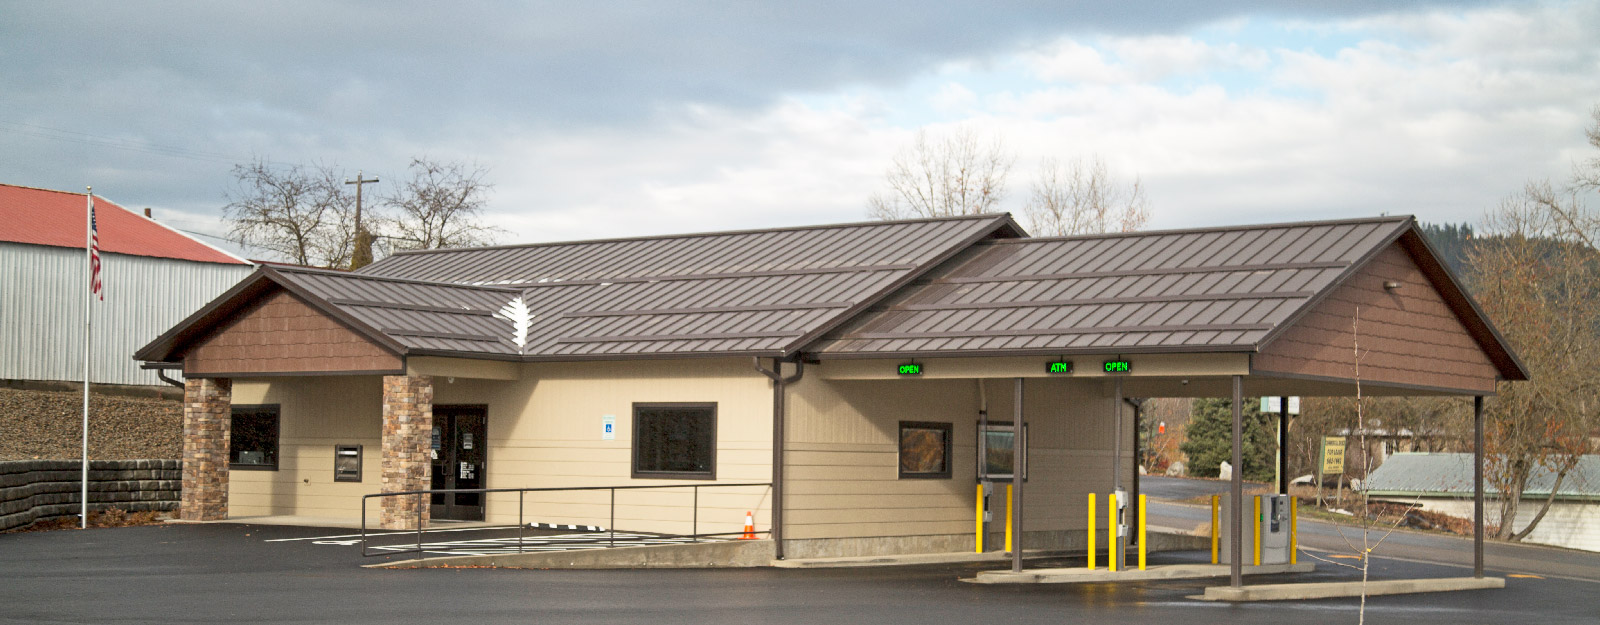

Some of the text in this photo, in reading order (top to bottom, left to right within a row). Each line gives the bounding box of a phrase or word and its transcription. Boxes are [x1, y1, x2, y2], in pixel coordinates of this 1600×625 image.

[899, 364, 919, 374] OPEN
[1050, 362, 1067, 373] ATM
[1105, 361, 1128, 372] OPEN
